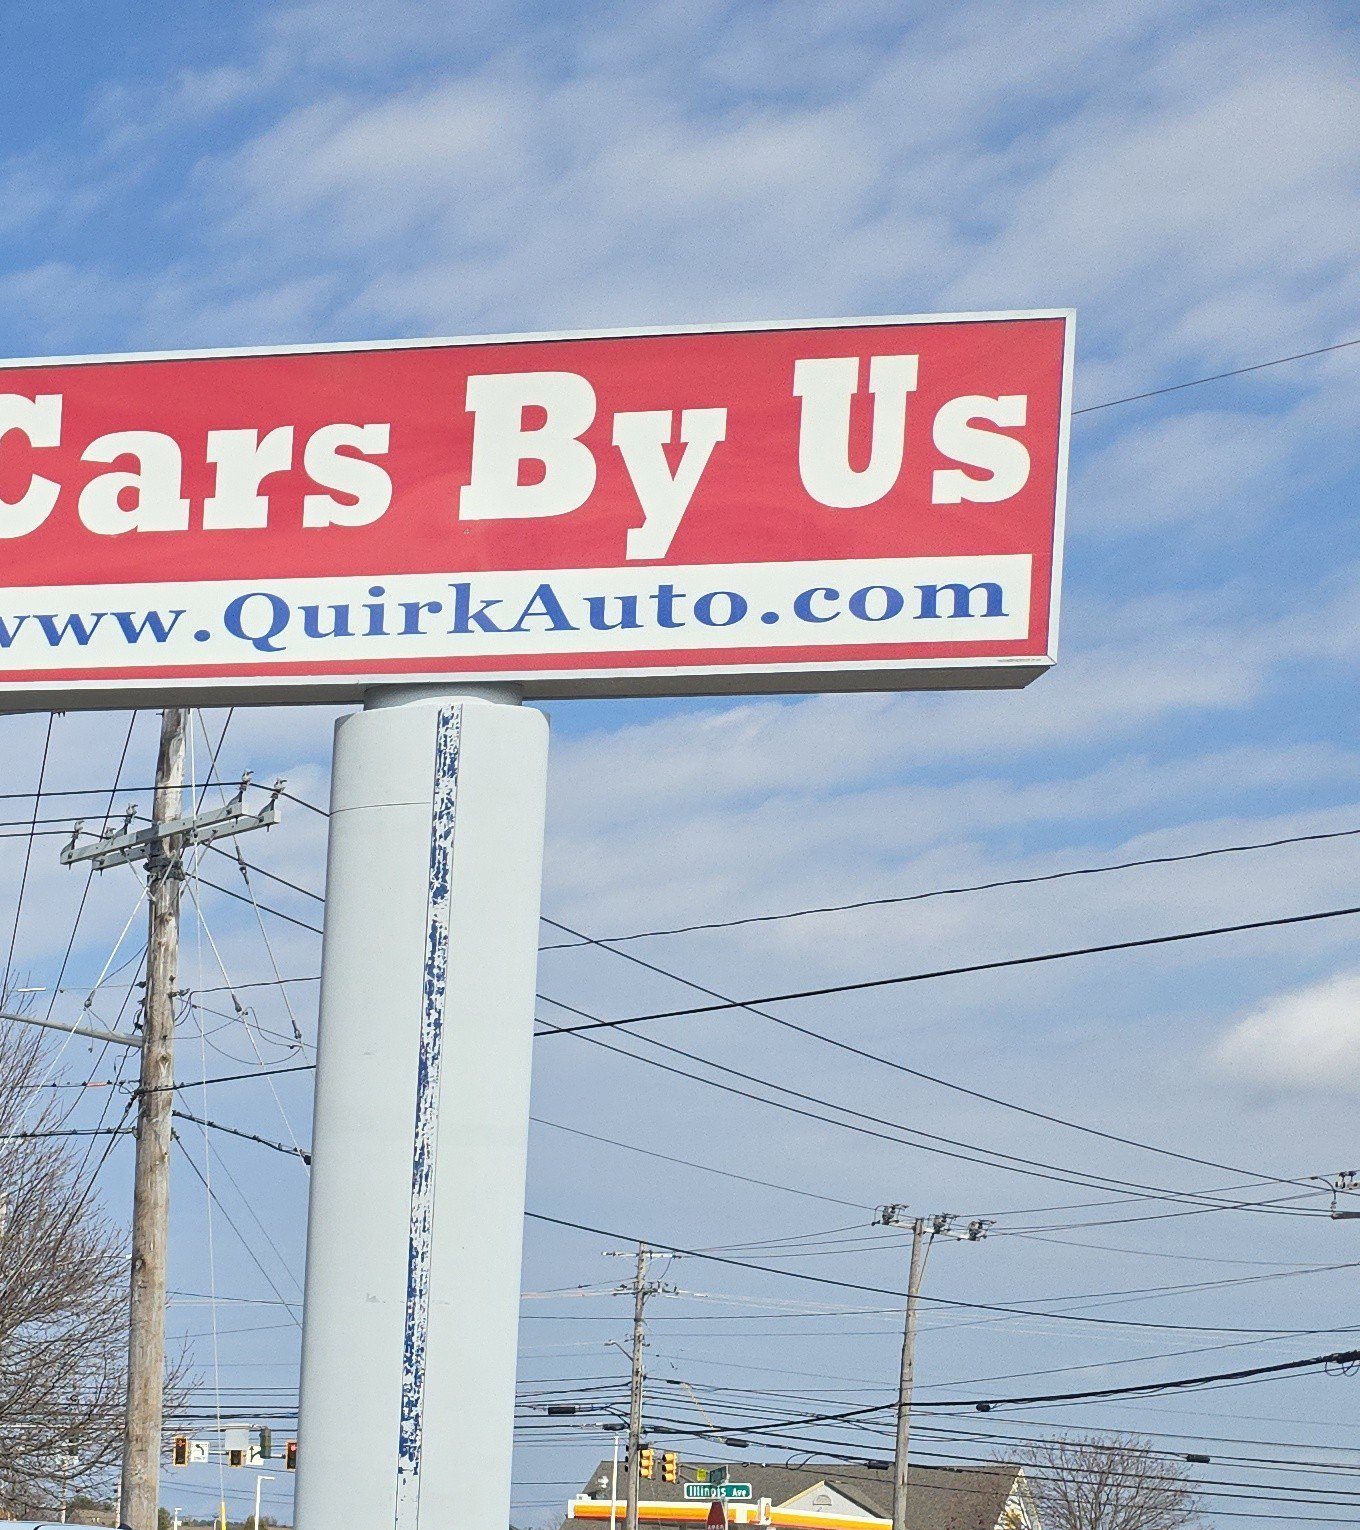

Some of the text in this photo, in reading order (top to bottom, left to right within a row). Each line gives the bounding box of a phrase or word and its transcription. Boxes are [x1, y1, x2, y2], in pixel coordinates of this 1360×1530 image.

[457, 371, 728, 561] By
[792, 354, 1031, 509] Us
[689, 1485, 747, 1497] Illinois Ave
